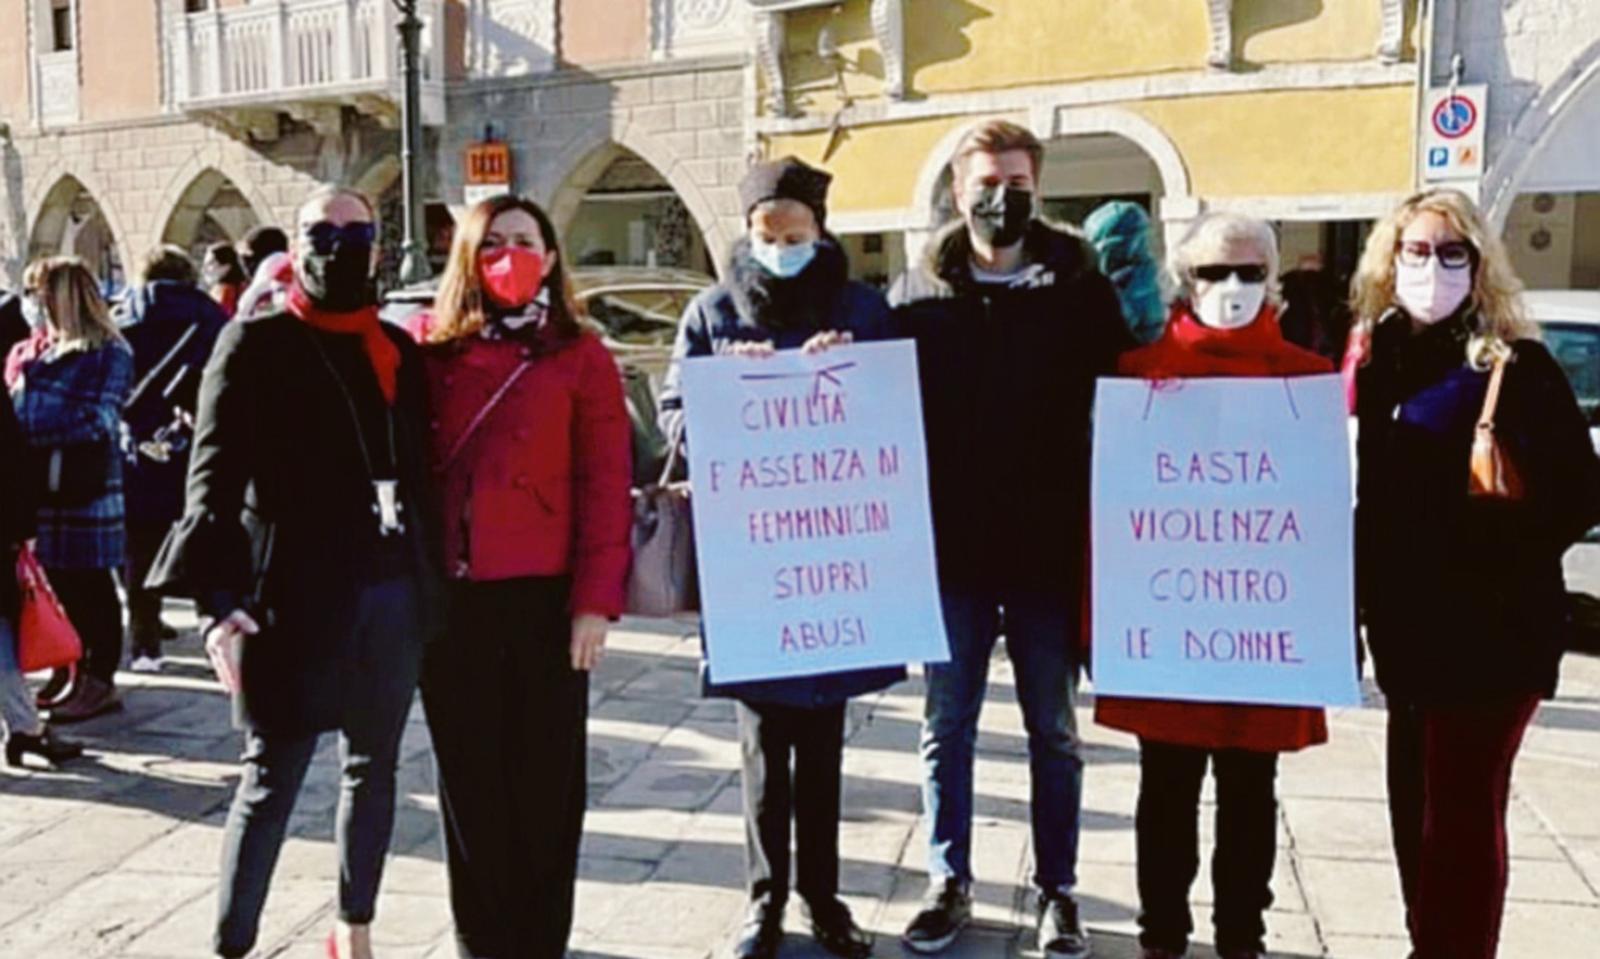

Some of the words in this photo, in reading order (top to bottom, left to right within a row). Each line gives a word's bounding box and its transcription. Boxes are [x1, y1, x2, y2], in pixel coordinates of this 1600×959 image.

[739, 448, 865, 489] ASSENZA
[1156, 451, 1279, 484] BASTA
[1129, 509, 1302, 544] VIOLENZA
[774, 560, 870, 600] STUPRI
[1149, 568, 1288, 603] CONTRO
[780, 617, 866, 652] ABUSI
[1125, 627, 1153, 660] LE
[1184, 627, 1305, 664] DONNE
